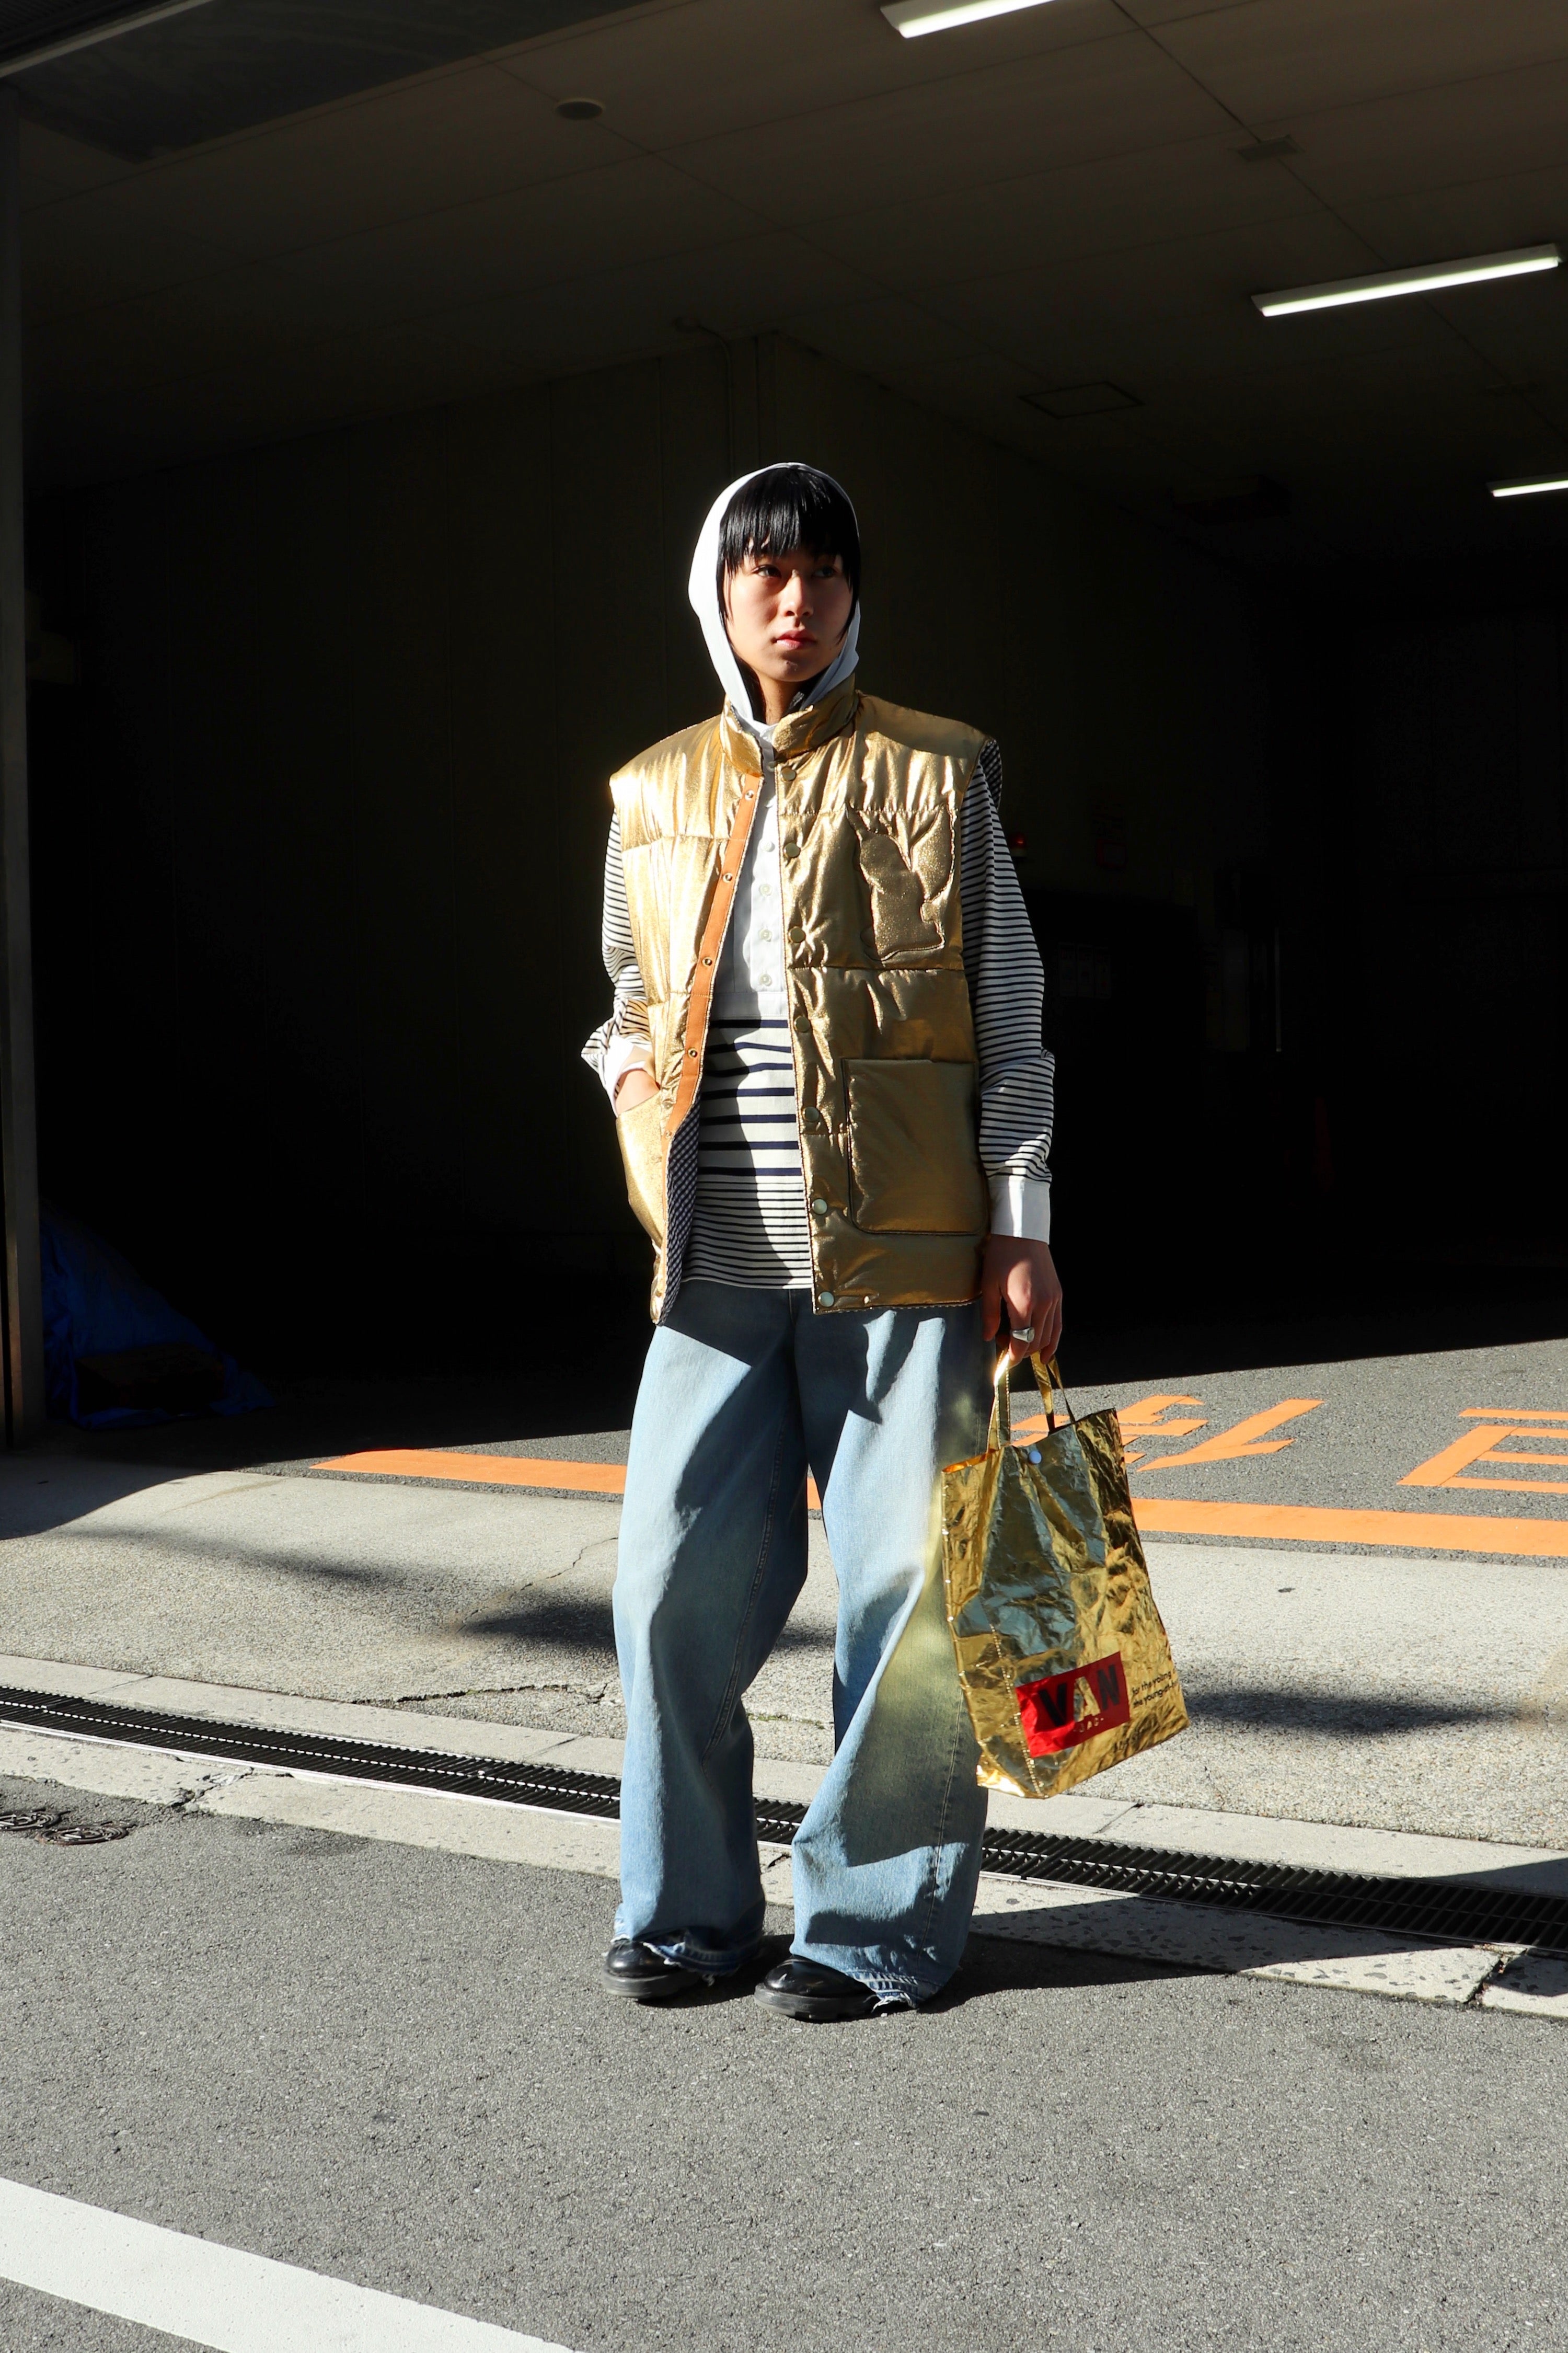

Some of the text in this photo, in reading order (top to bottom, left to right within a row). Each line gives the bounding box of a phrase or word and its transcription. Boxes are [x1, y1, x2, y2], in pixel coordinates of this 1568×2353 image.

[1038, 1665, 1120, 1726] VAN
[1141, 1681, 1152, 1691] the
[1152, 1671, 1172, 1688] young
